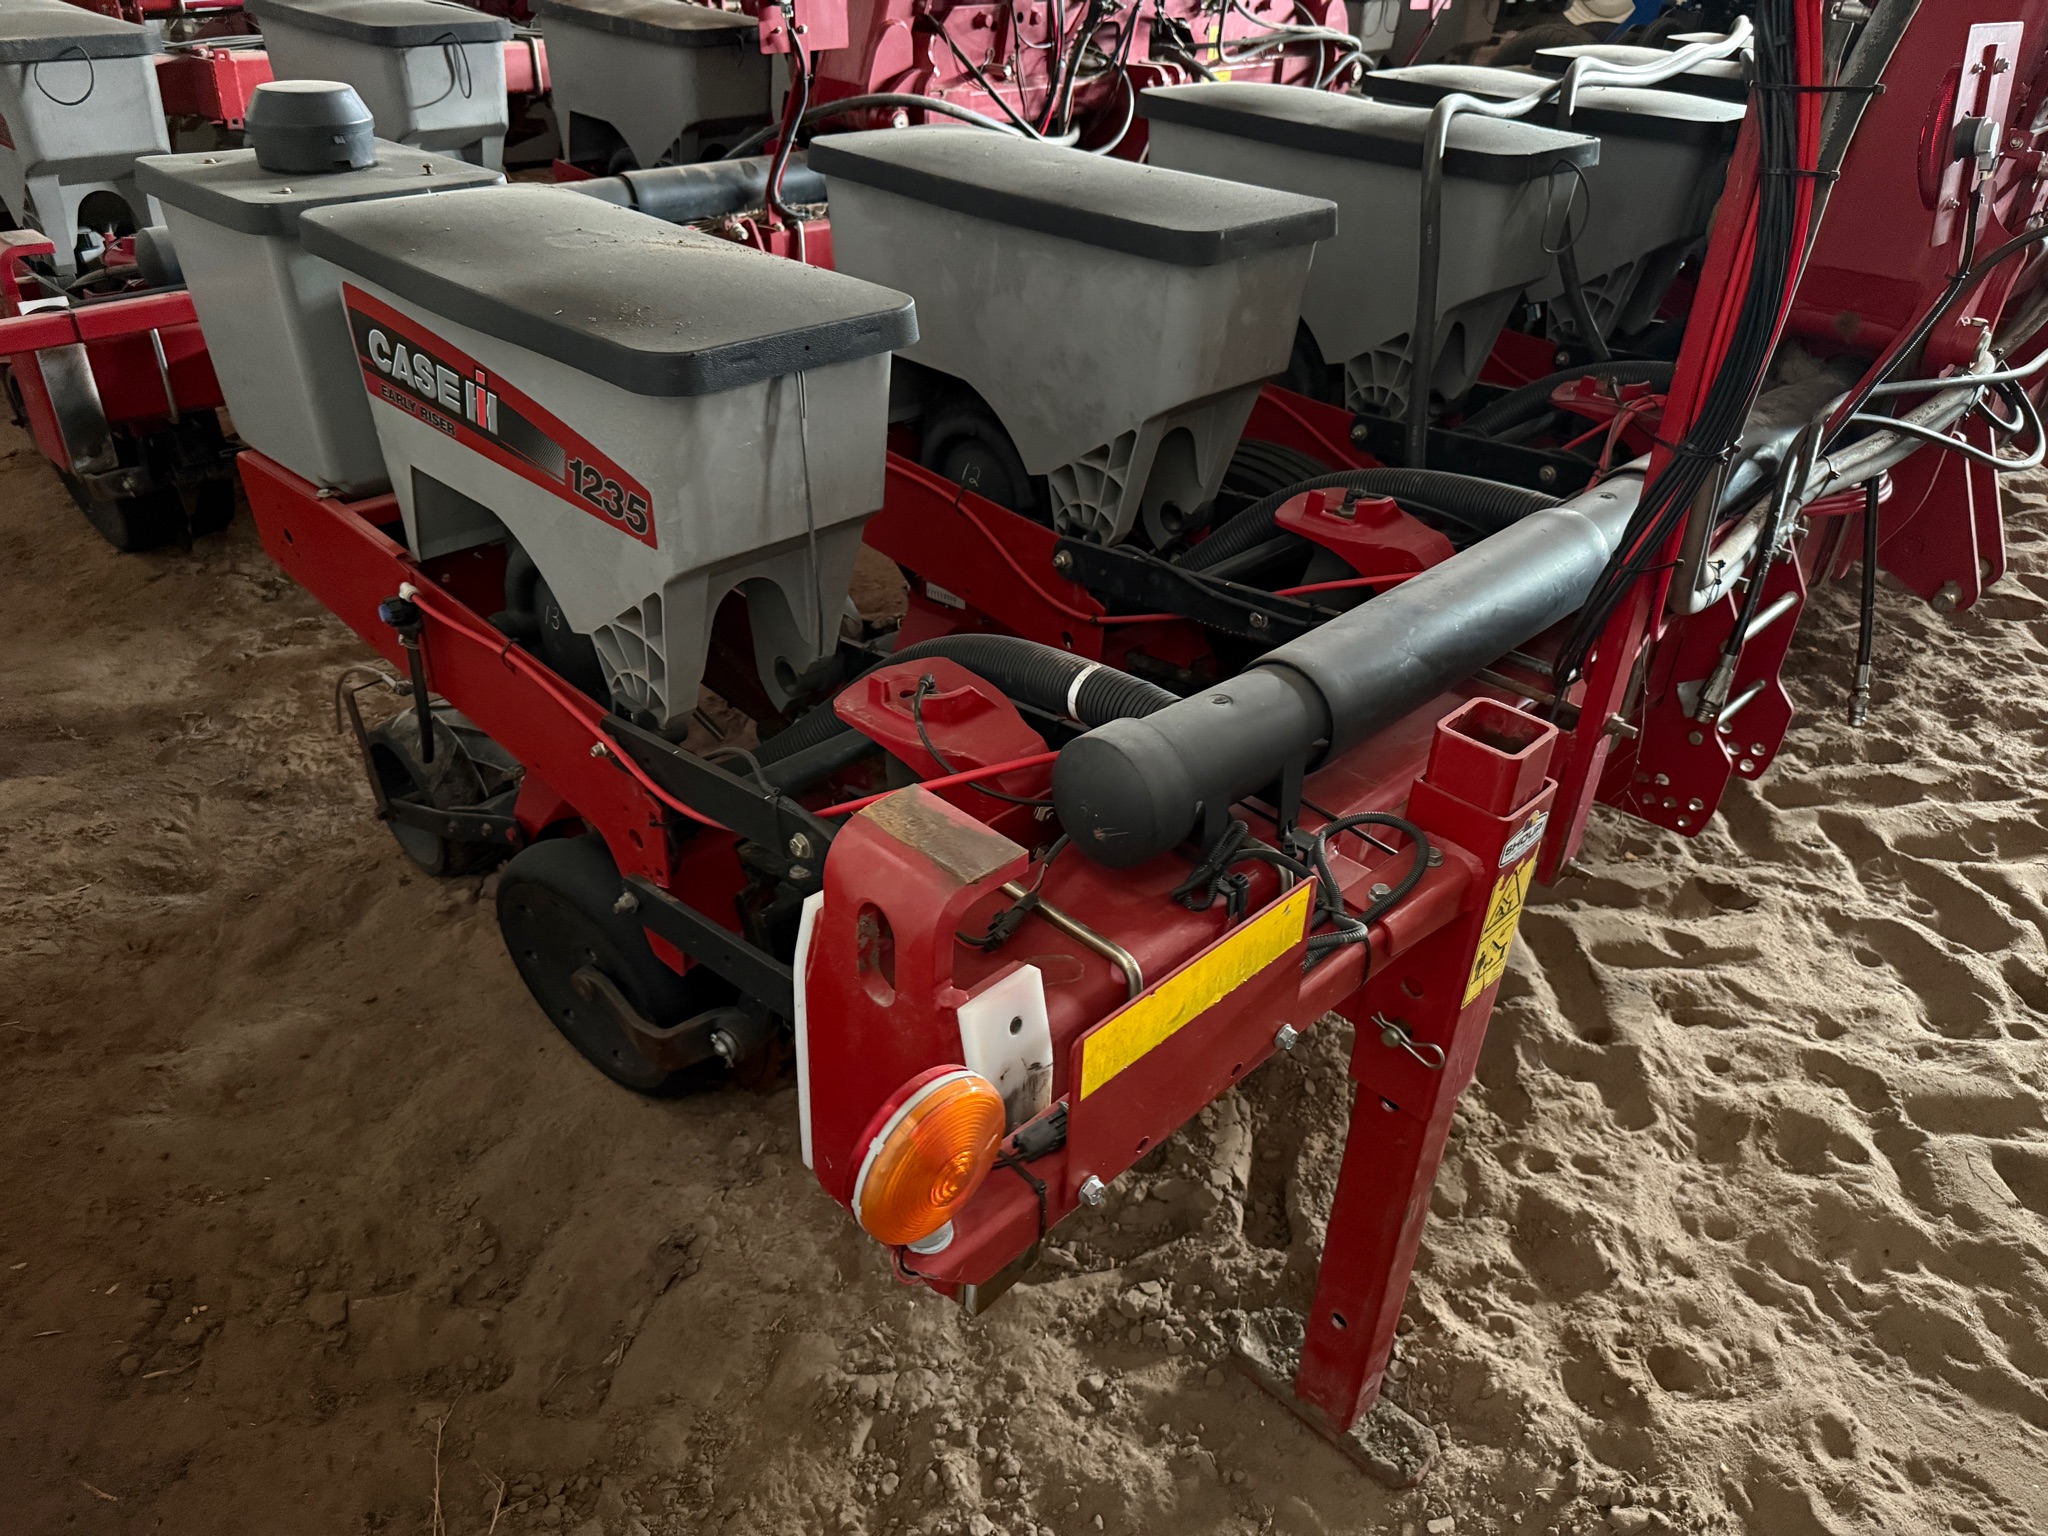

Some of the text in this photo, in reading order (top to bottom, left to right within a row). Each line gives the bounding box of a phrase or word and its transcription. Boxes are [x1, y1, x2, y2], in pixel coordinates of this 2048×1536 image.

[368, 328, 462, 415] CASE
[380, 382, 457, 438] EARLY RISER
[569, 457, 648, 534] 1235
[961, 462, 981, 488] 12
[545, 605, 560, 630] 13
[1504, 821, 1543, 857] SHOUP
